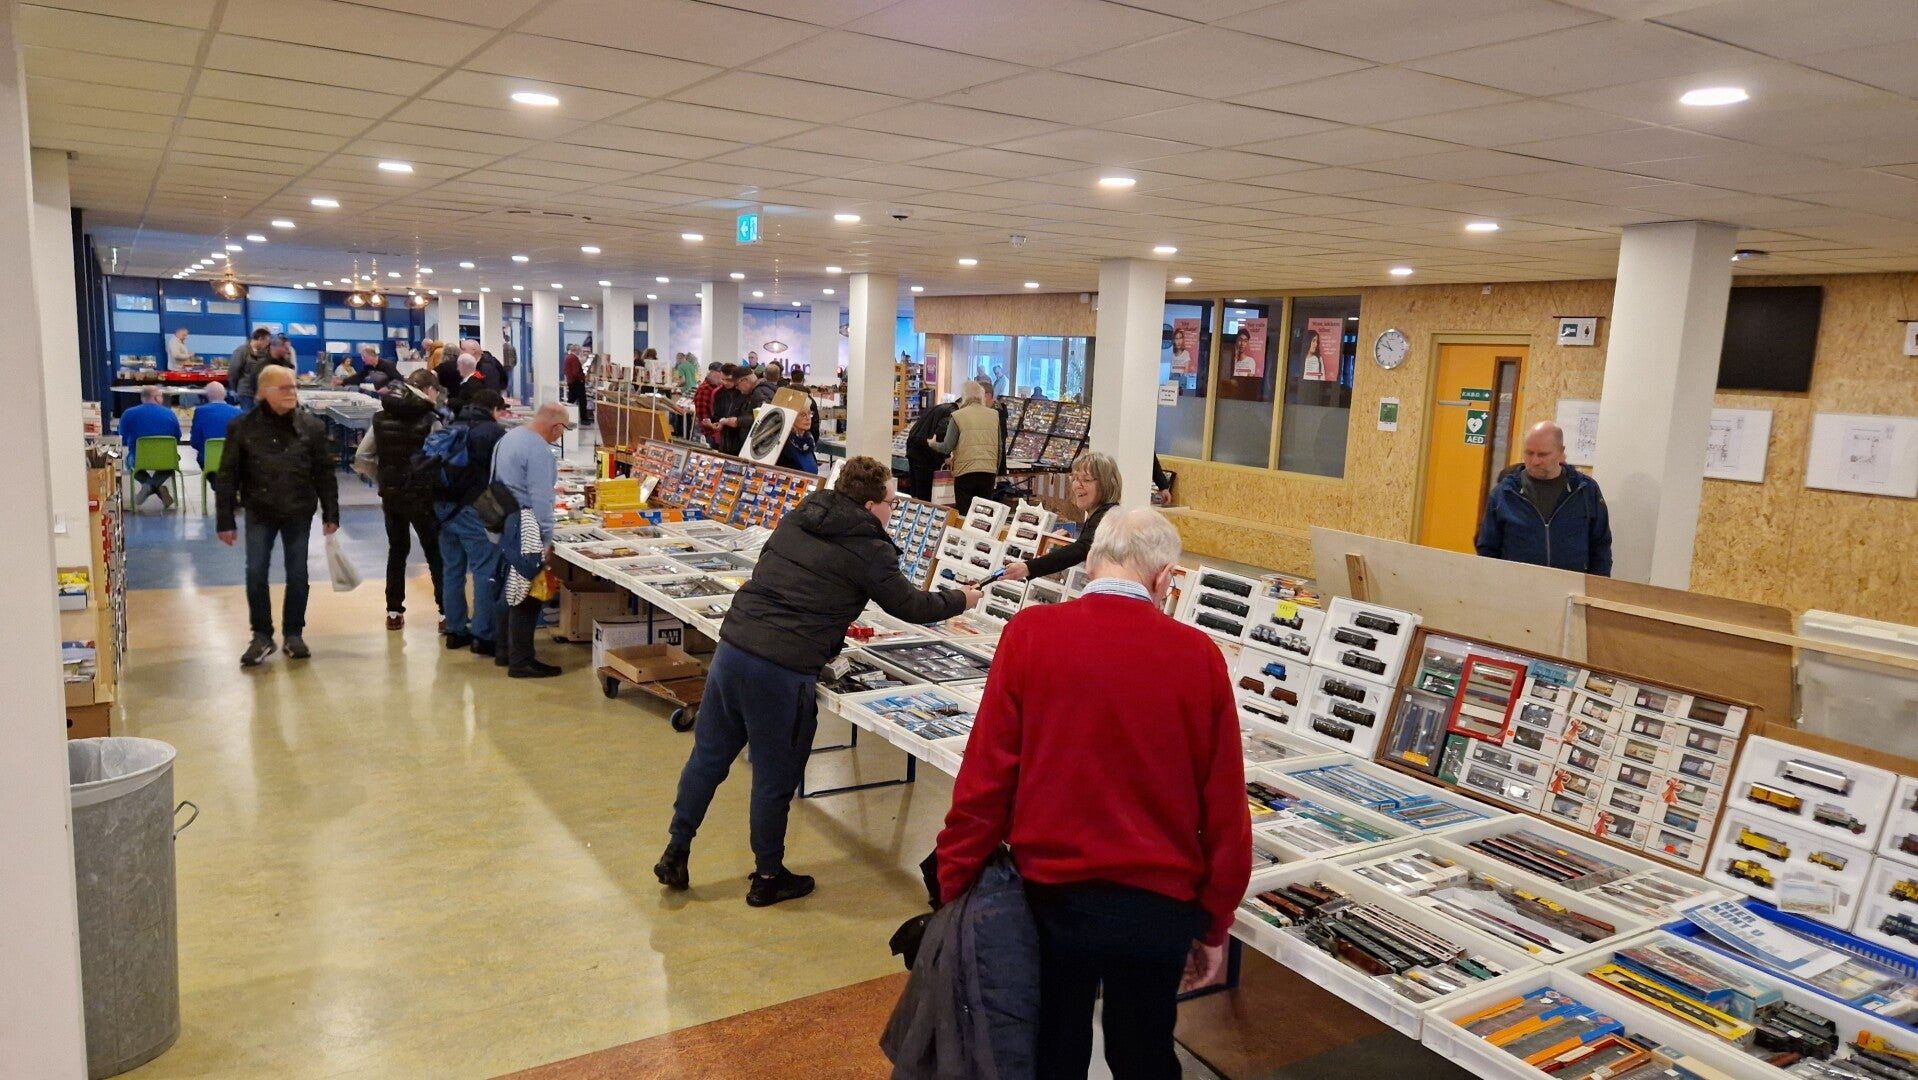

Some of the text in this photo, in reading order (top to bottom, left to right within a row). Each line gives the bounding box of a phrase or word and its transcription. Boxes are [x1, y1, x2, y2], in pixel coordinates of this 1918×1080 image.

[1466, 435, 1484, 444] AED
[1709, 905, 1752, 927] KUNT
[1750, 928, 1765, 937] U
[1720, 901, 1756, 922] HIER
